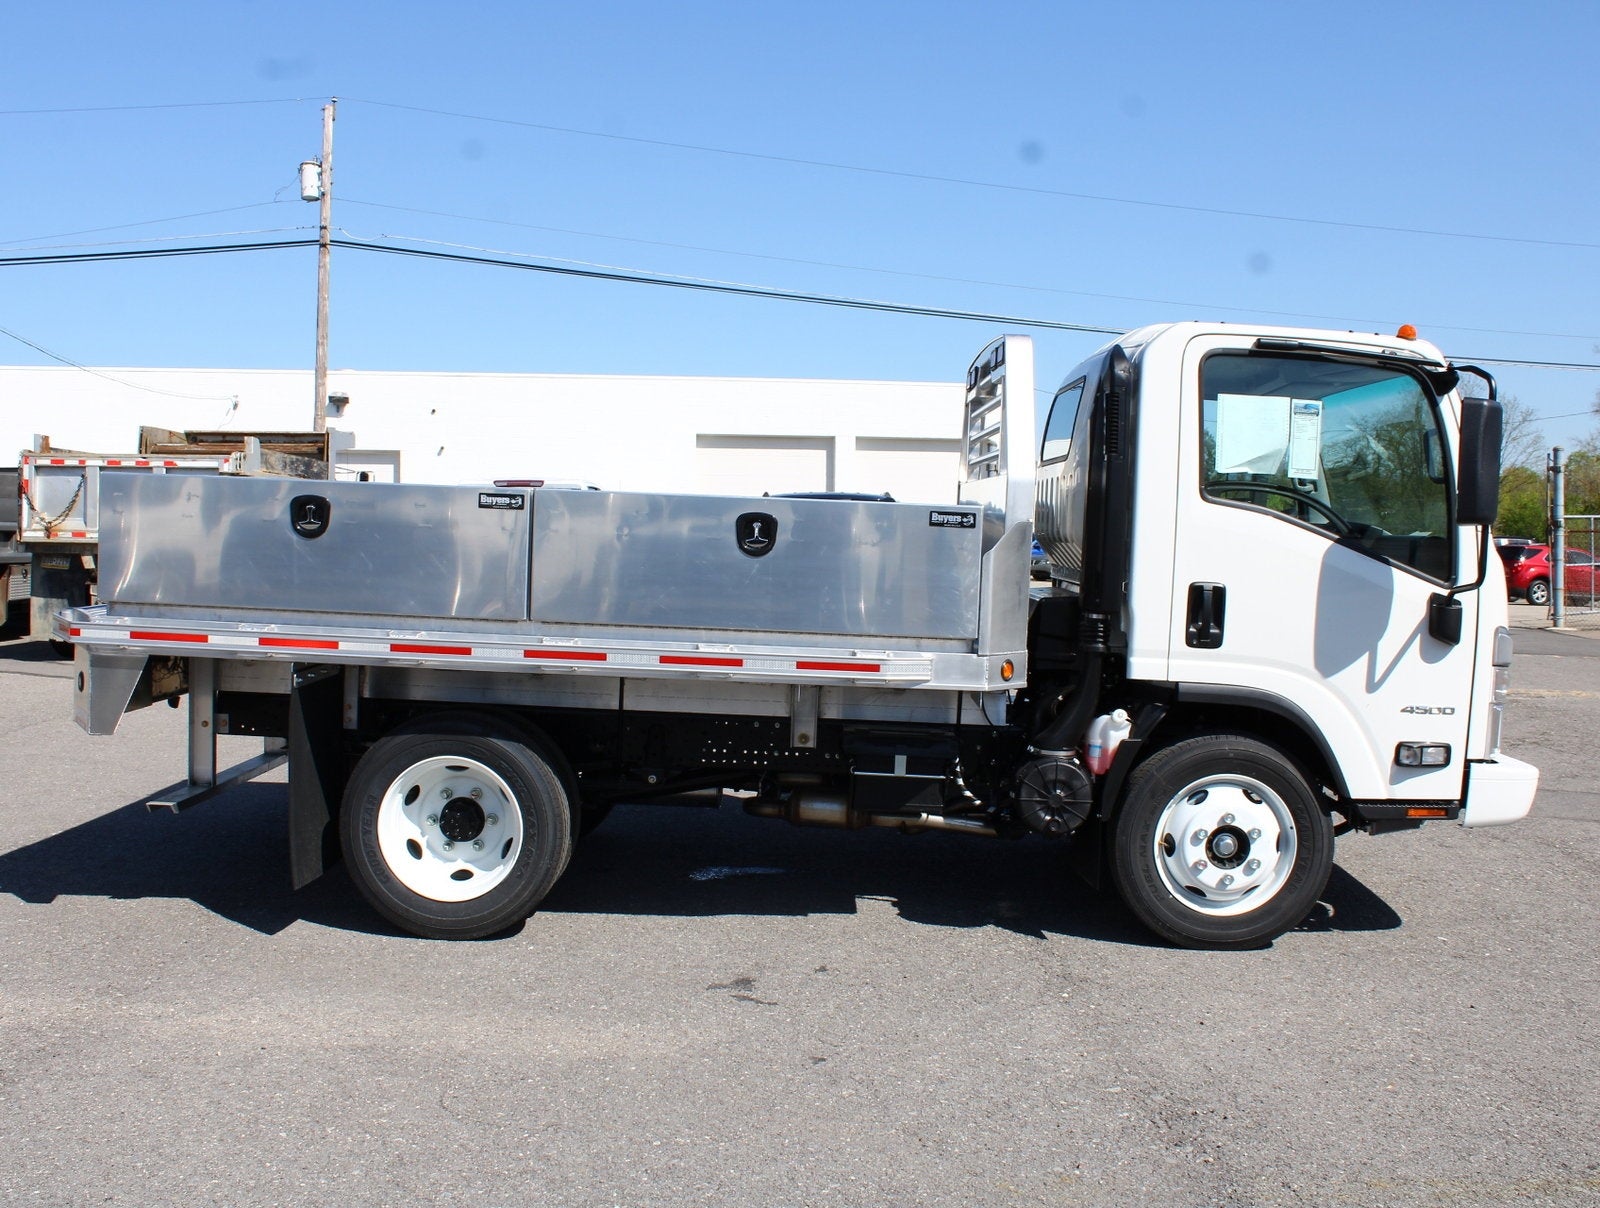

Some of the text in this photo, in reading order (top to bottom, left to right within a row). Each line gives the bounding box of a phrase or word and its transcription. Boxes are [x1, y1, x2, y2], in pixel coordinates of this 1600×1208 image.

[480, 494, 510, 505] Buyers
[931, 512, 961, 523] Buyers
[1400, 705, 1455, 715] 4500
[361, 793, 391, 884] GOODYEAR
